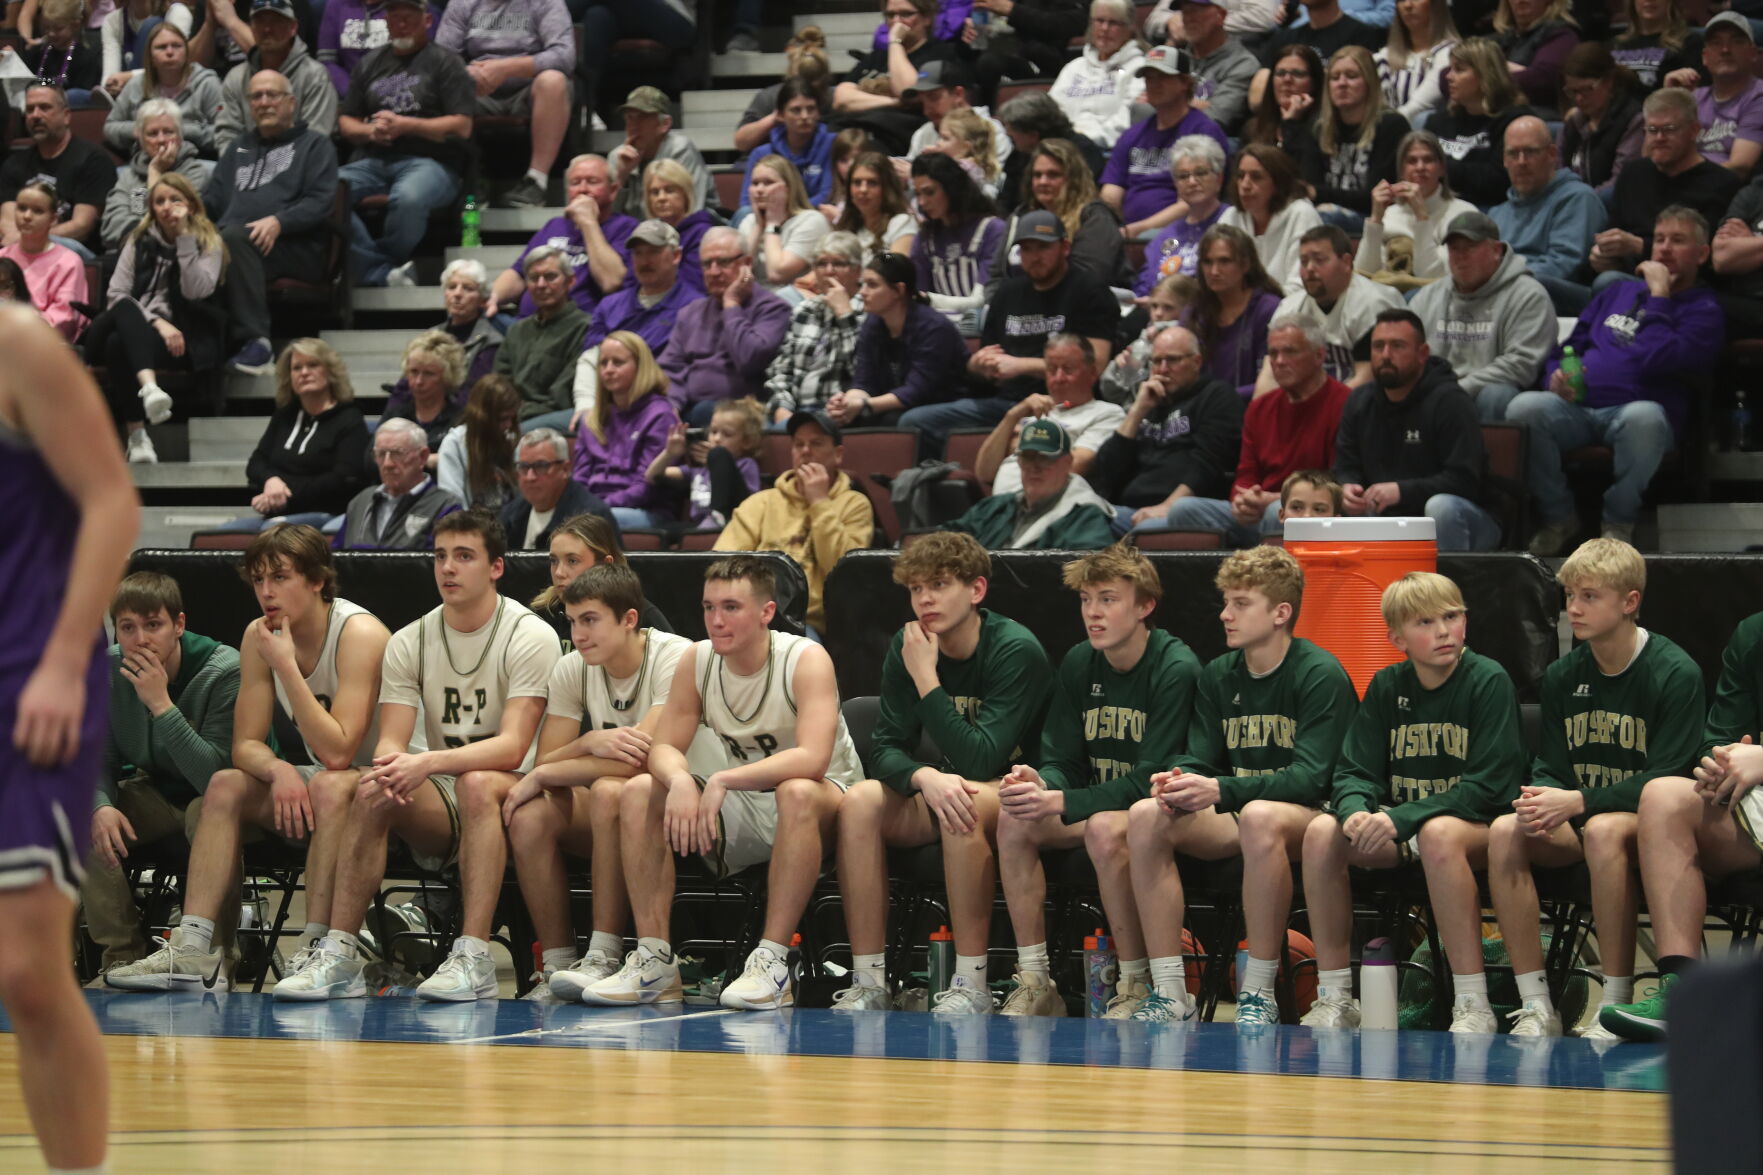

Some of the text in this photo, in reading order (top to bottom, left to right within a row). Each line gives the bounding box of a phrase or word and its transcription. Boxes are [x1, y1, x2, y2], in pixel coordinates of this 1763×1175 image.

[441, 686, 488, 725] R-P
[1082, 705, 1148, 743] USFO
[720, 733, 778, 761] R-P
